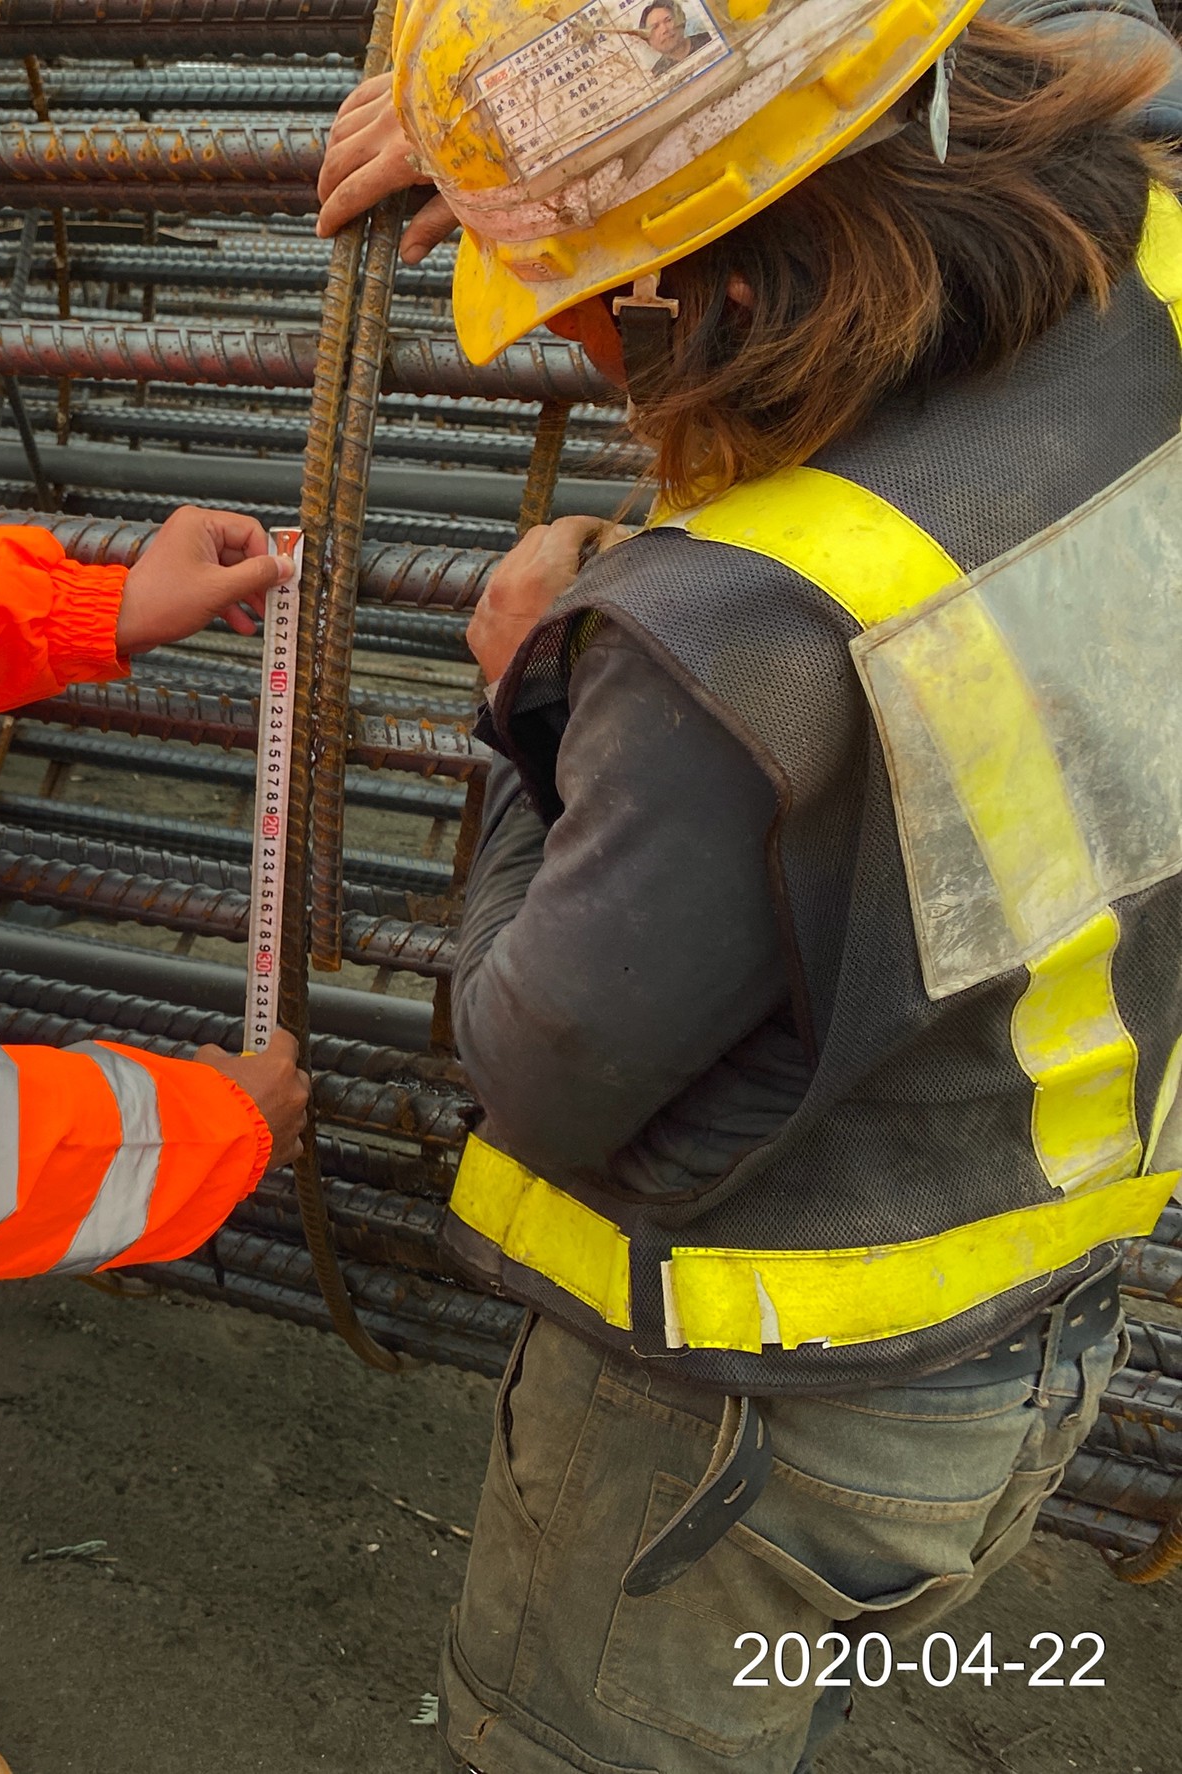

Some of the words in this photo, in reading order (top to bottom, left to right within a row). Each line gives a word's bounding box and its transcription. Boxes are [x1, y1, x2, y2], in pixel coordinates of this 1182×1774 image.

[278, 585, 290, 594] 4
[276, 601, 289, 610] 5
[276, 616, 289, 625] 6
[275, 631, 288, 641] 7
[274, 647, 287, 656] 8
[273, 661, 286, 670] 9
[271, 673, 287, 691] 10
[271, 706, 283, 715] 2
[270, 720, 283, 729] 3
[269, 735, 282, 743] 4
[269, 749, 281, 758] 5
[268, 764, 280, 772] 6
[267, 778, 279, 787] 7
[266, 792, 278, 801] 8
[265, 806, 278, 814] 9
[263, 816, 279, 835] 20
[263, 848, 275, 857] 2
[263, 862, 275, 871] 3
[262, 876, 274, 884] 4
[261, 889, 274, 898] 5
[261, 904, 273, 912] 6
[260, 917, 272, 926] 7
[260, 931, 272, 939] 8
[259, 944, 271, 952] 9
[256, 953, 272, 972] 30
[257, 985, 269, 993] 2
[256, 998, 268, 1006] 3
[255, 1011, 268, 1019] 4
[255, 1024, 267, 1033] 5
[254, 1038, 267, 1046] 6
